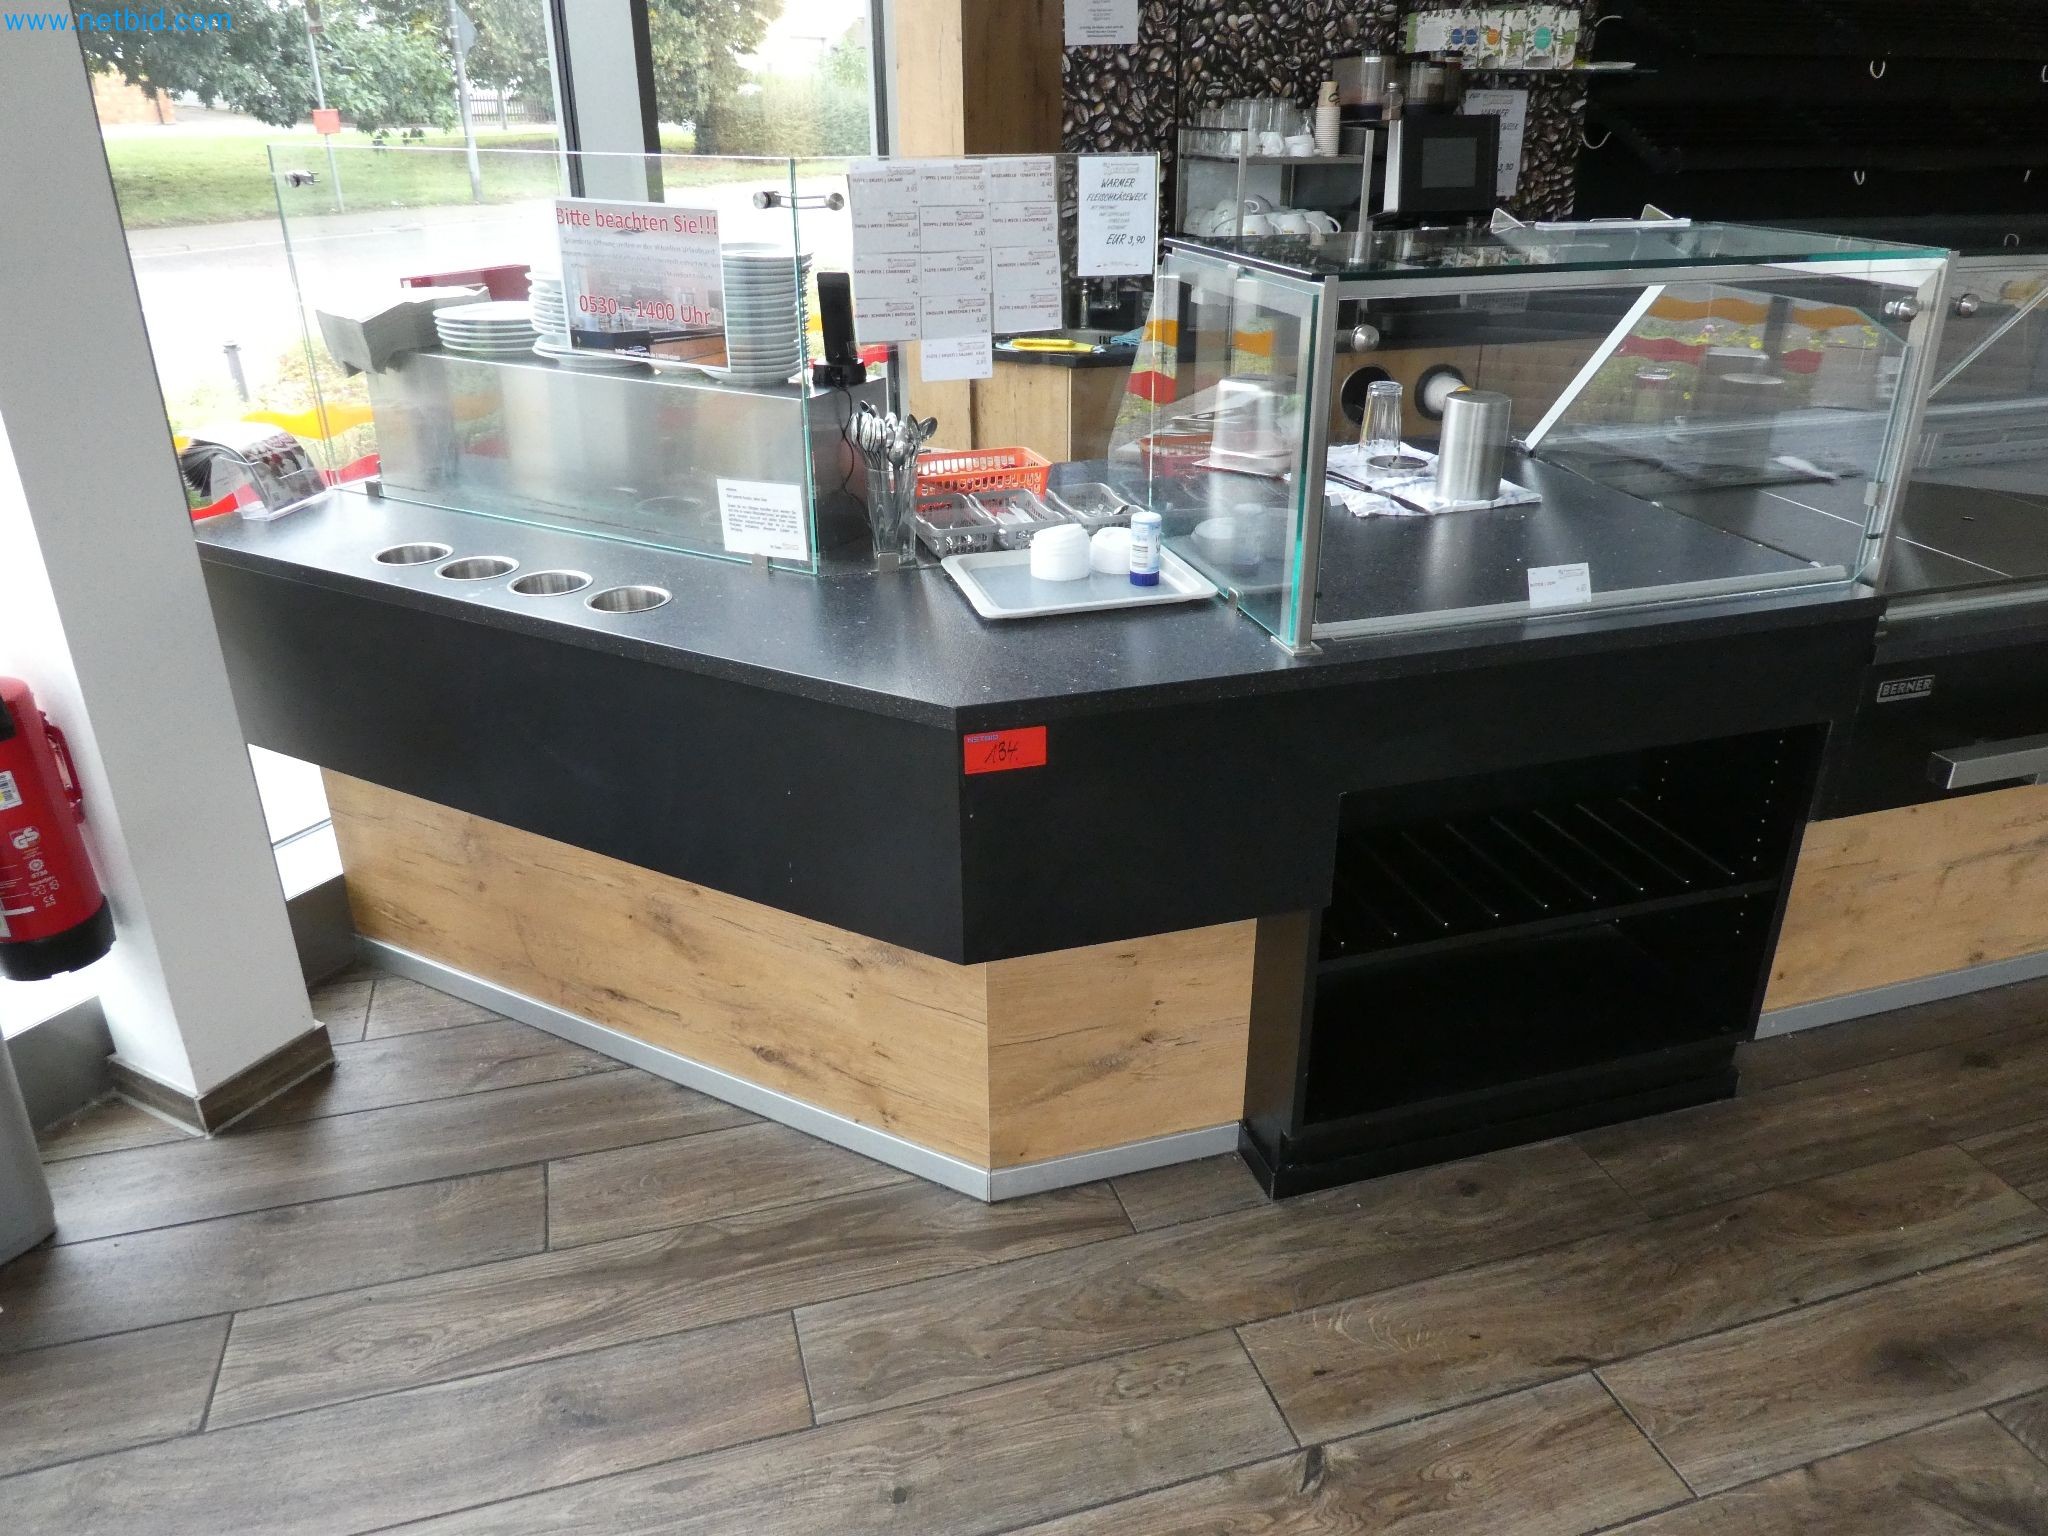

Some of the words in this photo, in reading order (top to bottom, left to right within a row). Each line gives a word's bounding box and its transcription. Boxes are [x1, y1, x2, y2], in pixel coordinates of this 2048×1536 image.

[1100, 177, 1136, 188] WARMER
[556, 207, 590, 227] Bitte
[595, 209, 669, 231] beachten
[674, 215, 718, 235] Sie!!!
[1106, 234, 1127, 245] EUR
[1127, 235, 1146, 246] 3,90
[579, 295, 617, 315] 0530
[635, 300, 675, 321] 1400
[680, 305, 711, 325] Uhr
[1881, 679, 1932, 696] BERNER
